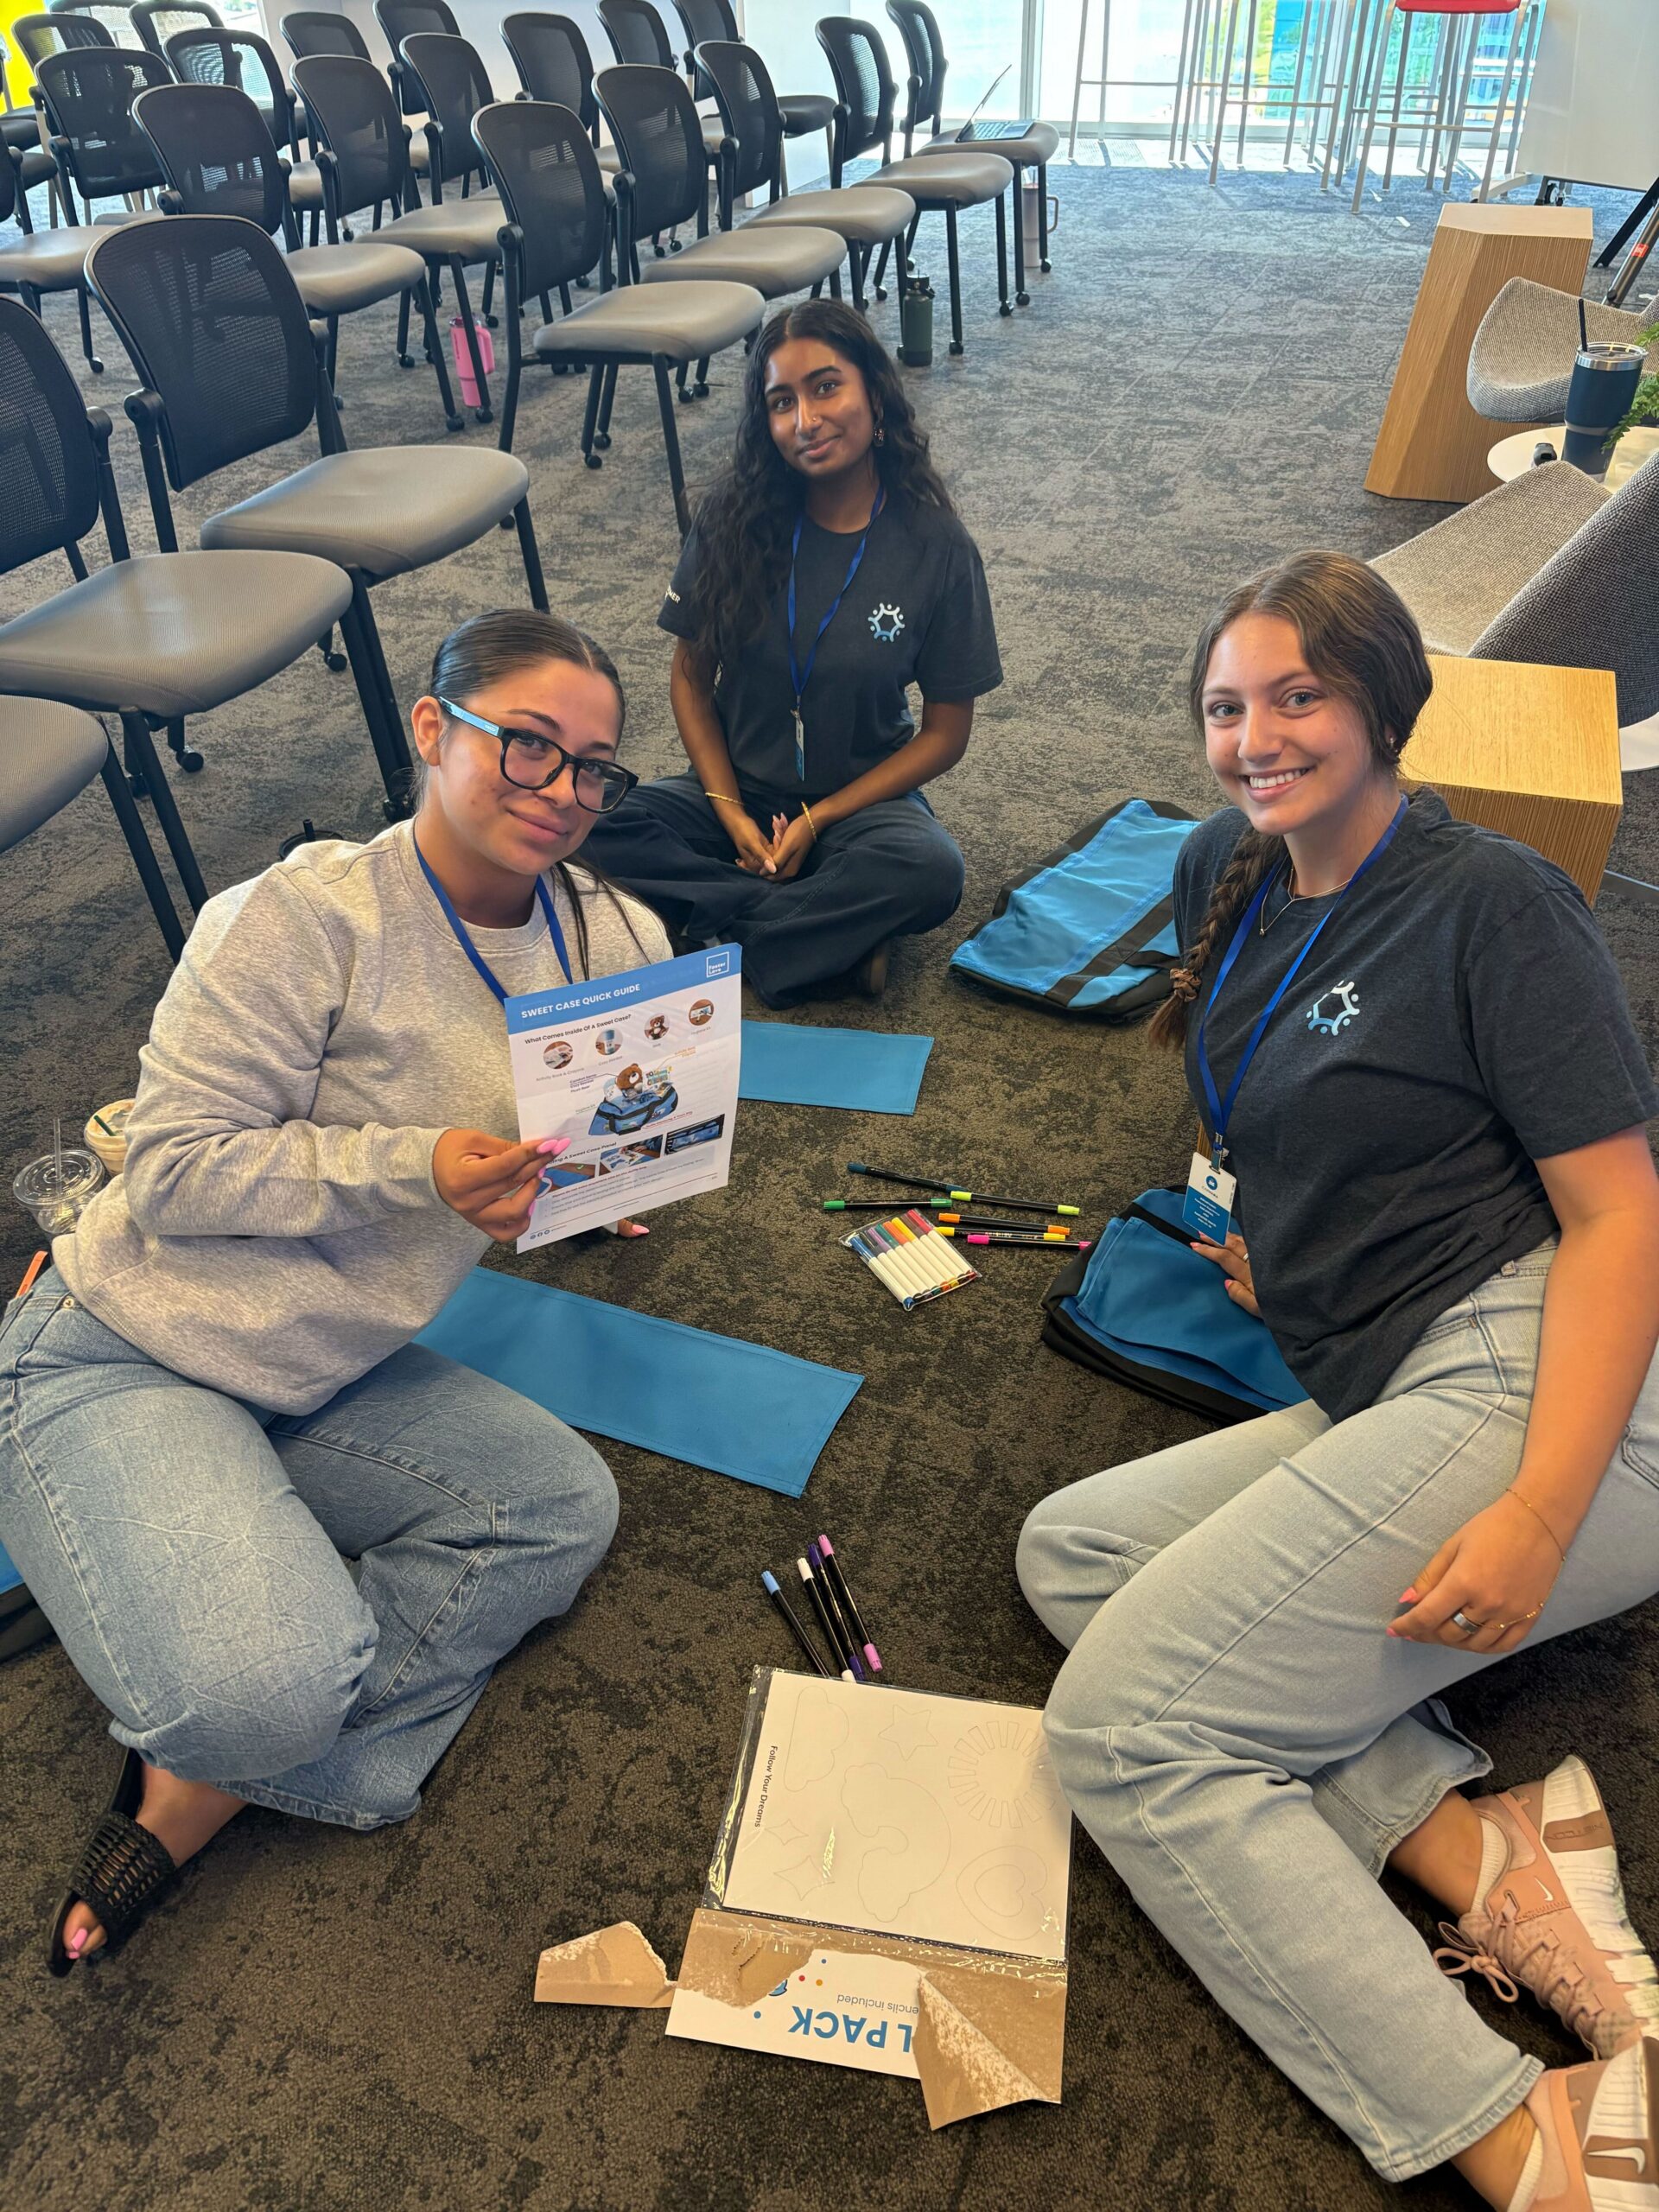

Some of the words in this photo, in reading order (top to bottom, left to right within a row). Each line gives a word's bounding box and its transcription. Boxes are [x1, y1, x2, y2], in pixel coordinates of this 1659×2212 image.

[521, 1005, 553, 1019] SWEET
[555, 999, 581, 1011] CASE
[582, 991, 612, 1005] QUICK
[613, 983, 640, 997] GUIDE
[524, 1036, 542, 1045] What
[543, 1032, 564, 1040] Comes
[564, 1027, 583, 1036] Inside
[596, 1020, 613, 1028] Sweet
[614, 1014, 632, 1022] Case?
[766, 1745, 778, 1773] Follow
[763, 1774, 772, 1794] Your
[754, 1794, 767, 1827] Dreams
[836, 1994, 886, 2009] included
[887, 2002, 919, 2014] encils
[788, 2005, 888, 2049] PACK
